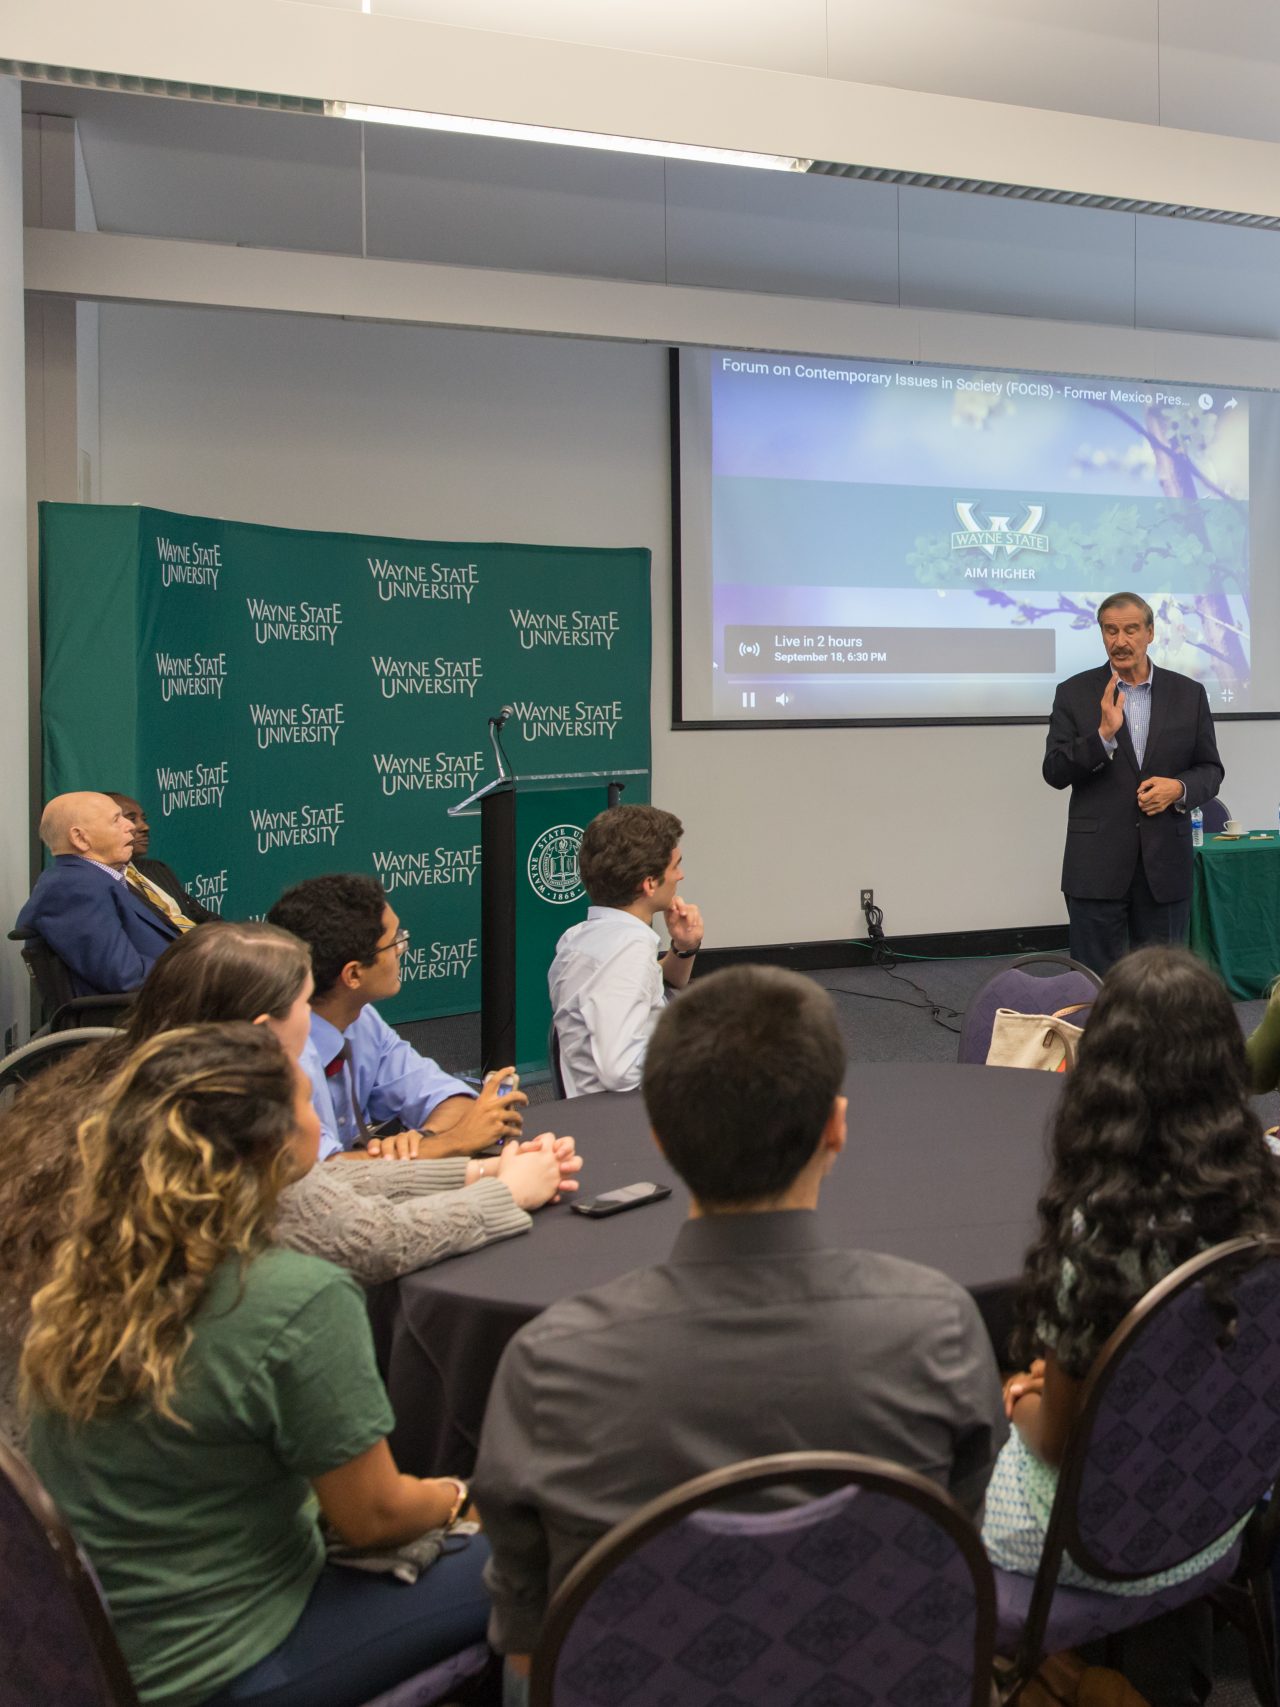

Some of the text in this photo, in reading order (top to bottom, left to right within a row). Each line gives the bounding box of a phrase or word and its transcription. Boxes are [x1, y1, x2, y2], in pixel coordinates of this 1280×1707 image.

[722, 357, 769, 375] Forum
[773, 364, 791, 377] on
[795, 364, 892, 388] Contemporary
[895, 372, 938, 389] Issues
[941, 377, 953, 390] in
[956, 378, 1002, 395] Society
[1006, 380, 1054, 398] (FOCIS)
[1064, 386, 1106, 401] Former
[1110, 389, 1153, 404] Mexico
[156, 536, 222, 567] WAYNE STATE
[956, 532, 1043, 549] WAYNE STATE
[162, 563, 219, 591] UNIVERSITY
[367, 558, 480, 583] WAYNE STATE
[964, 567, 1036, 579] AIM HIGHER
[378, 581, 474, 604] UNIVERSITY
[246, 598, 343, 624] WAYNE STATE
[509, 609, 620, 630] WAYNE STATE
[255, 622, 338, 646] UNIVERSITY
[520, 630, 615, 650] UNIVERSITY
[774, 635, 863, 648] Live in 2 hours
[156, 653, 227, 676] WAYNE STATE
[371, 656, 483, 677] WAYNE STATE
[774, 652, 887, 663] September 18, 6:30 PM
[162, 677, 224, 702] UNIVERSITY
[381, 678, 478, 699] UNIVERSITY
[250, 703, 344, 726] WAYNE STATE
[513, 701, 623, 721] WAYNE STATE
[257, 726, 340, 749] UNIVERSITY
[522, 721, 617, 742] UNIVERSITY
[373, 752, 485, 774] WAYNE STATE
[157, 762, 229, 791] WAYNE STATE
[382, 772, 479, 796] UNIVERSITY
[162, 786, 225, 816] UNIVERSITY
[250, 803, 344, 831] WAYNE STATE
[257, 825, 340, 854] UNIVERSITY
[372, 845, 481, 871] WAYNE STATE
[531, 828, 566, 893] WAYNE STATE
[195, 869, 228, 897] STATE
[381, 866, 477, 893] UNIVERSITY
[552, 890, 576, 900] 1868
[430, 938, 478, 962] STATE
